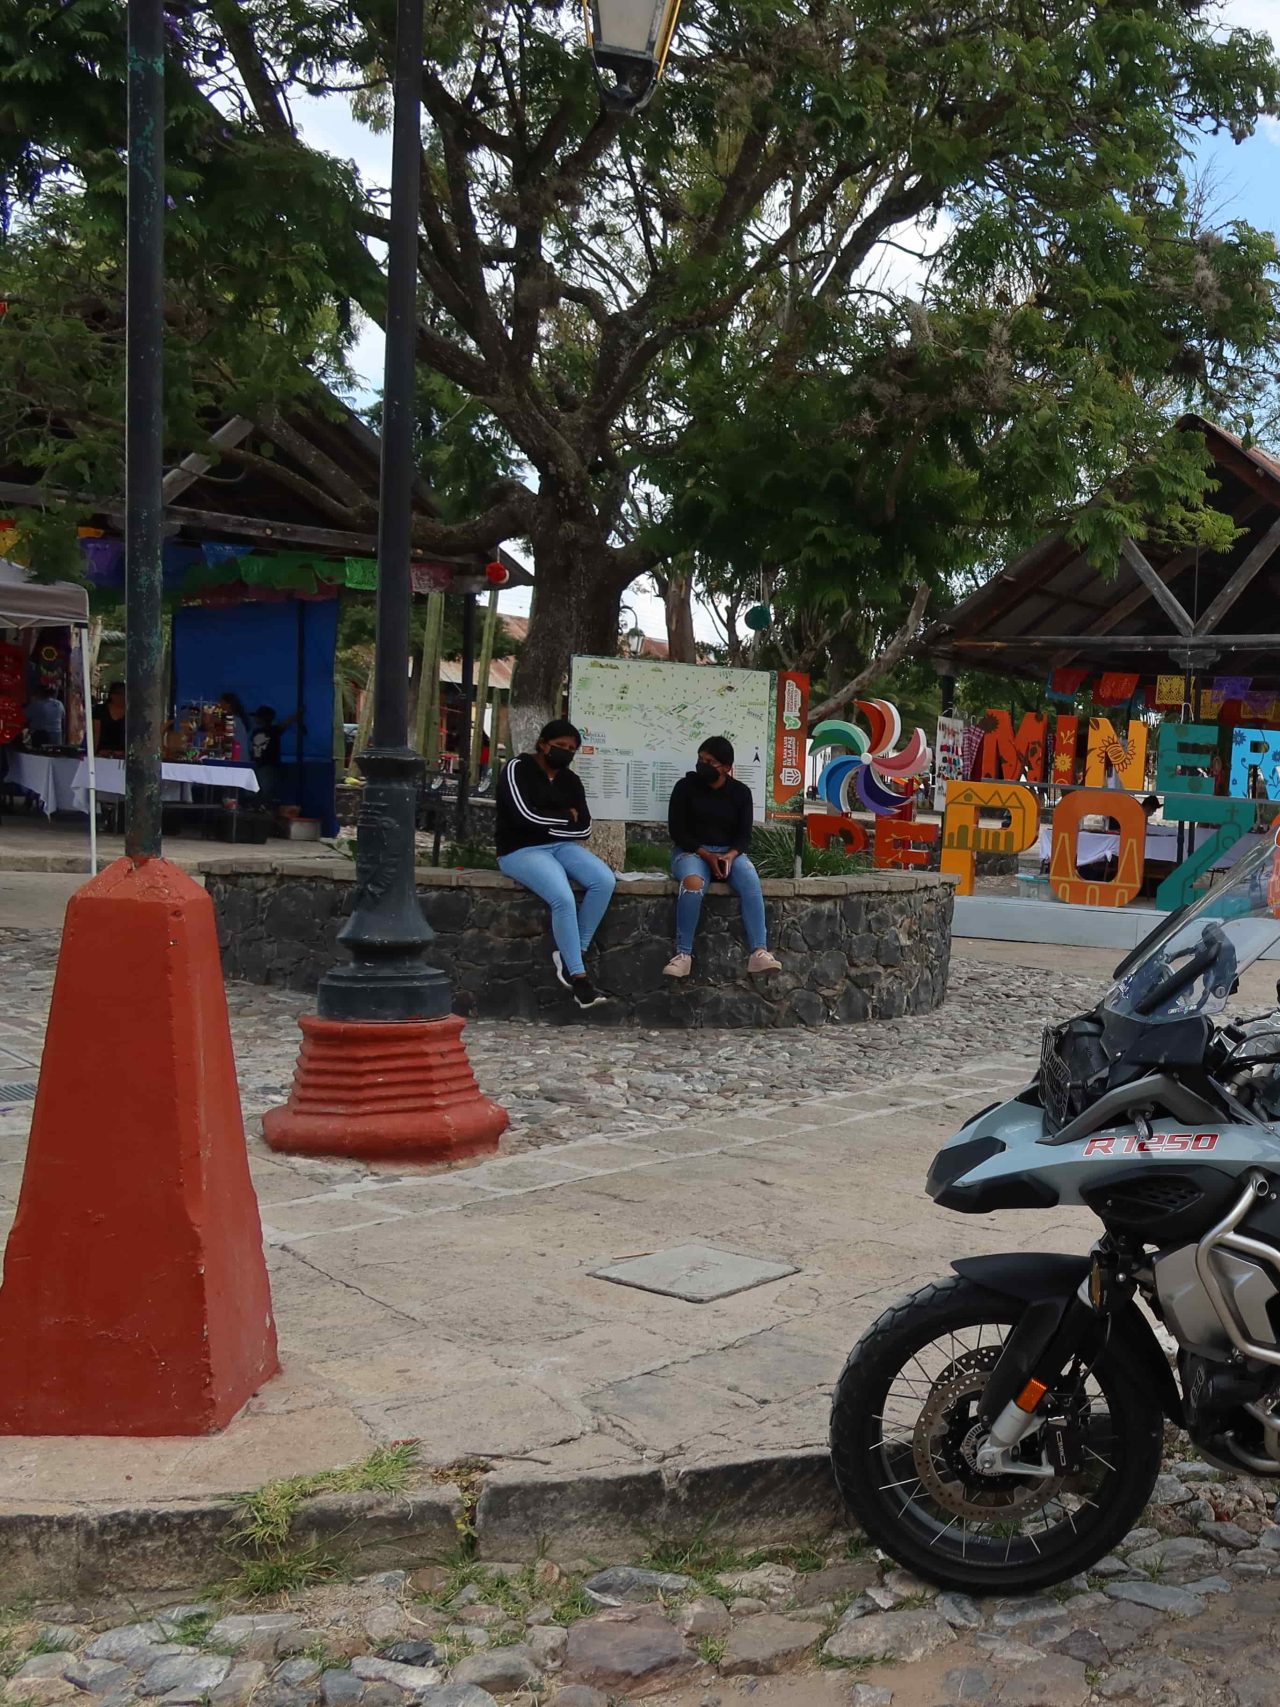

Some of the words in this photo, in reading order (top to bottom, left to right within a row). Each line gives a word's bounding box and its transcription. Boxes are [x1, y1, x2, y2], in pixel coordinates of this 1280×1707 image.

[806, 812, 939, 869] DE
[1083, 1136, 1117, 1157] R
[1122, 1132, 1220, 1154] 1250
